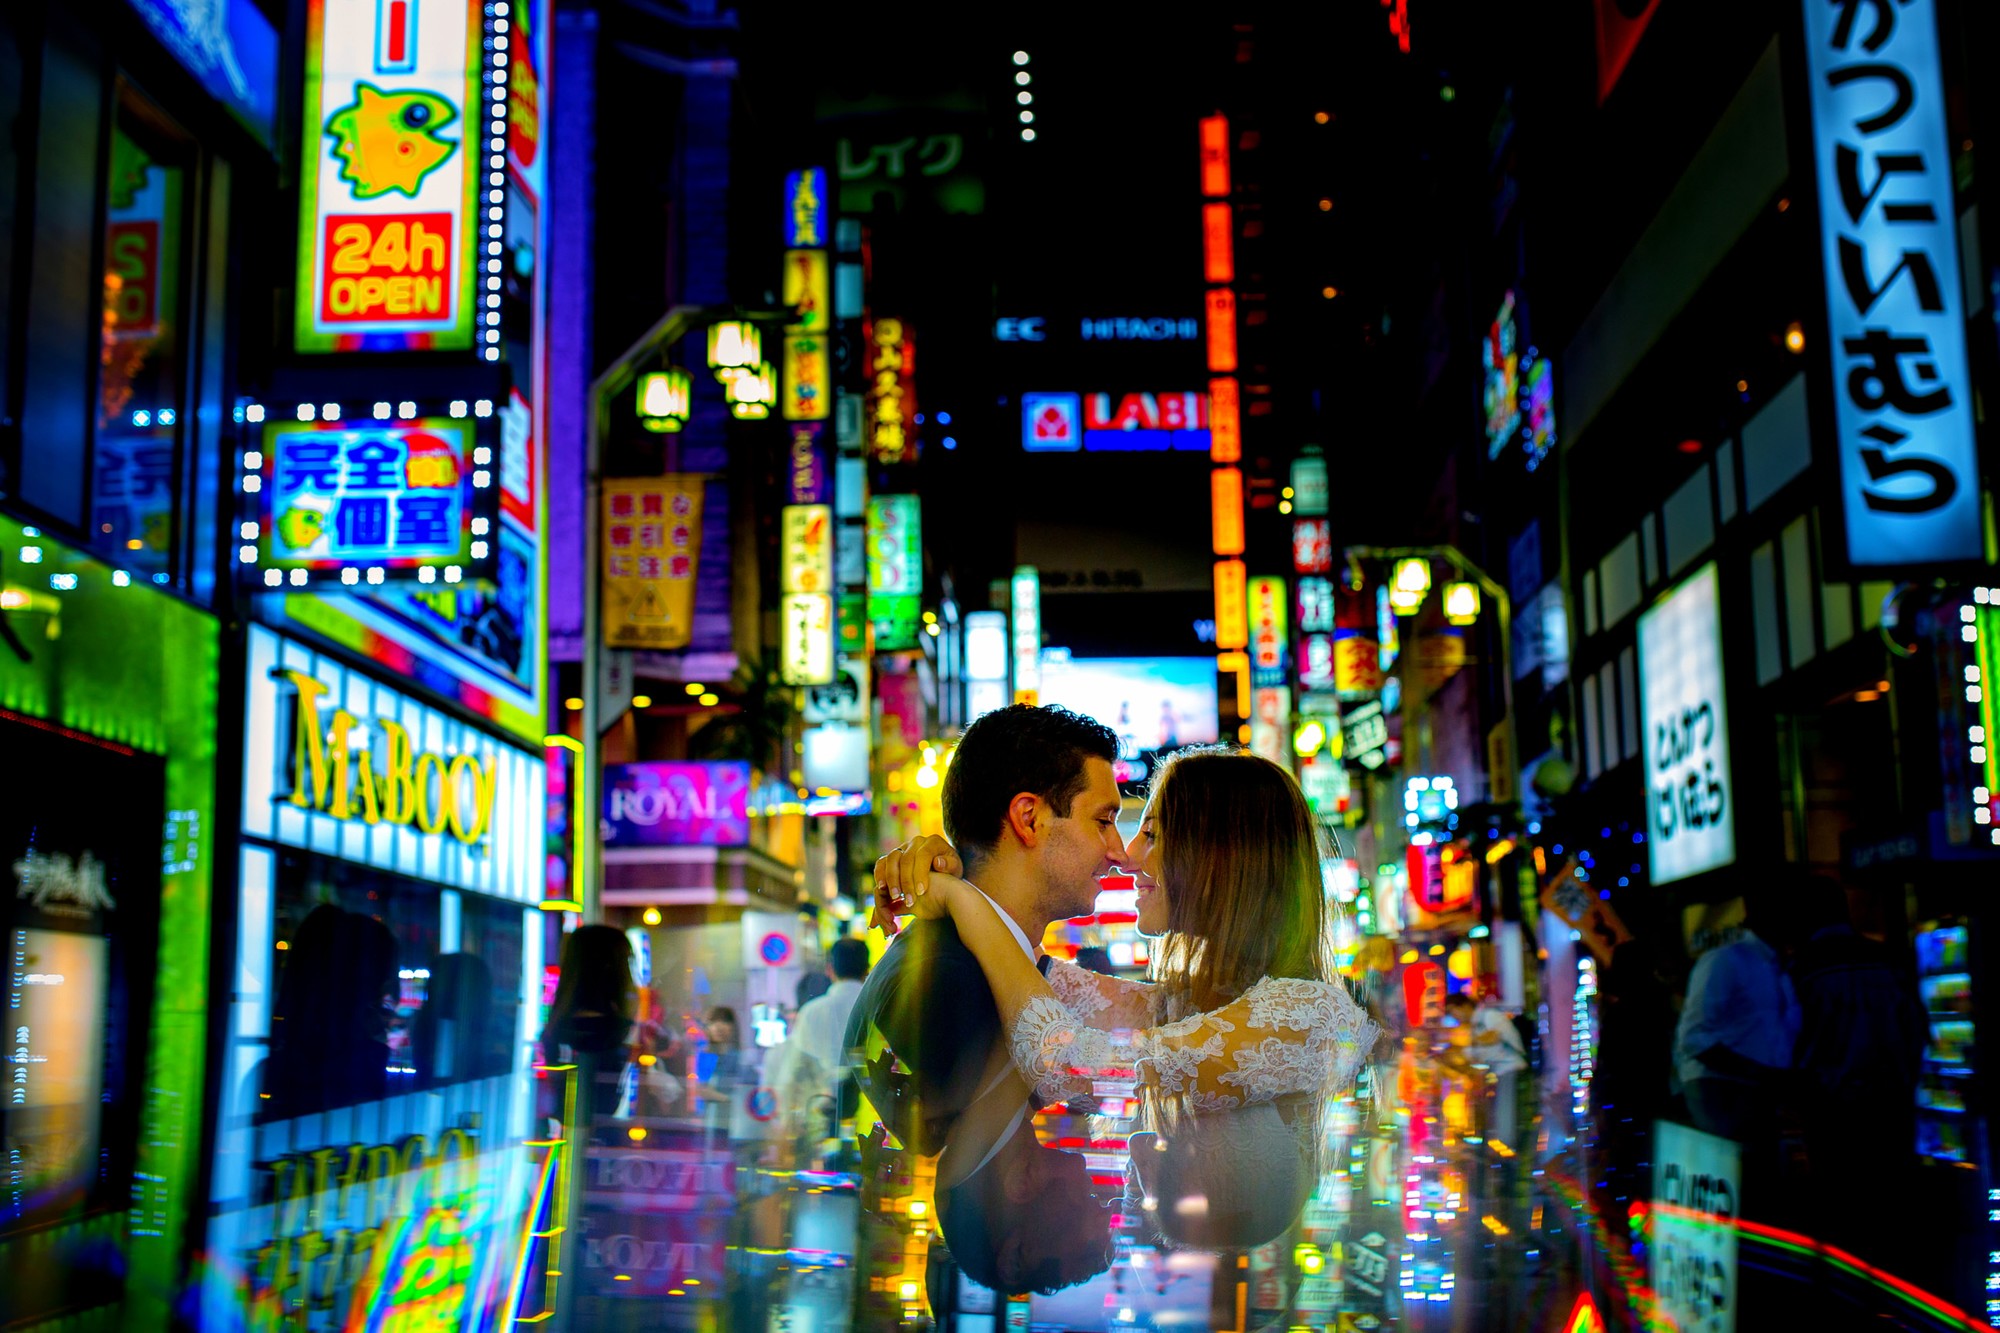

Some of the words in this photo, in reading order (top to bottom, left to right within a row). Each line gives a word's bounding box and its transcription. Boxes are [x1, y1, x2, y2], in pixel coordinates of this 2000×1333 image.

[836, 133, 962, 180] レイク
[332, 221, 445, 274] 24h
[329, 275, 441, 315] OPEN
[1081, 316, 1198, 341] HITACHI
[611, 785, 732, 826] ROYAL
